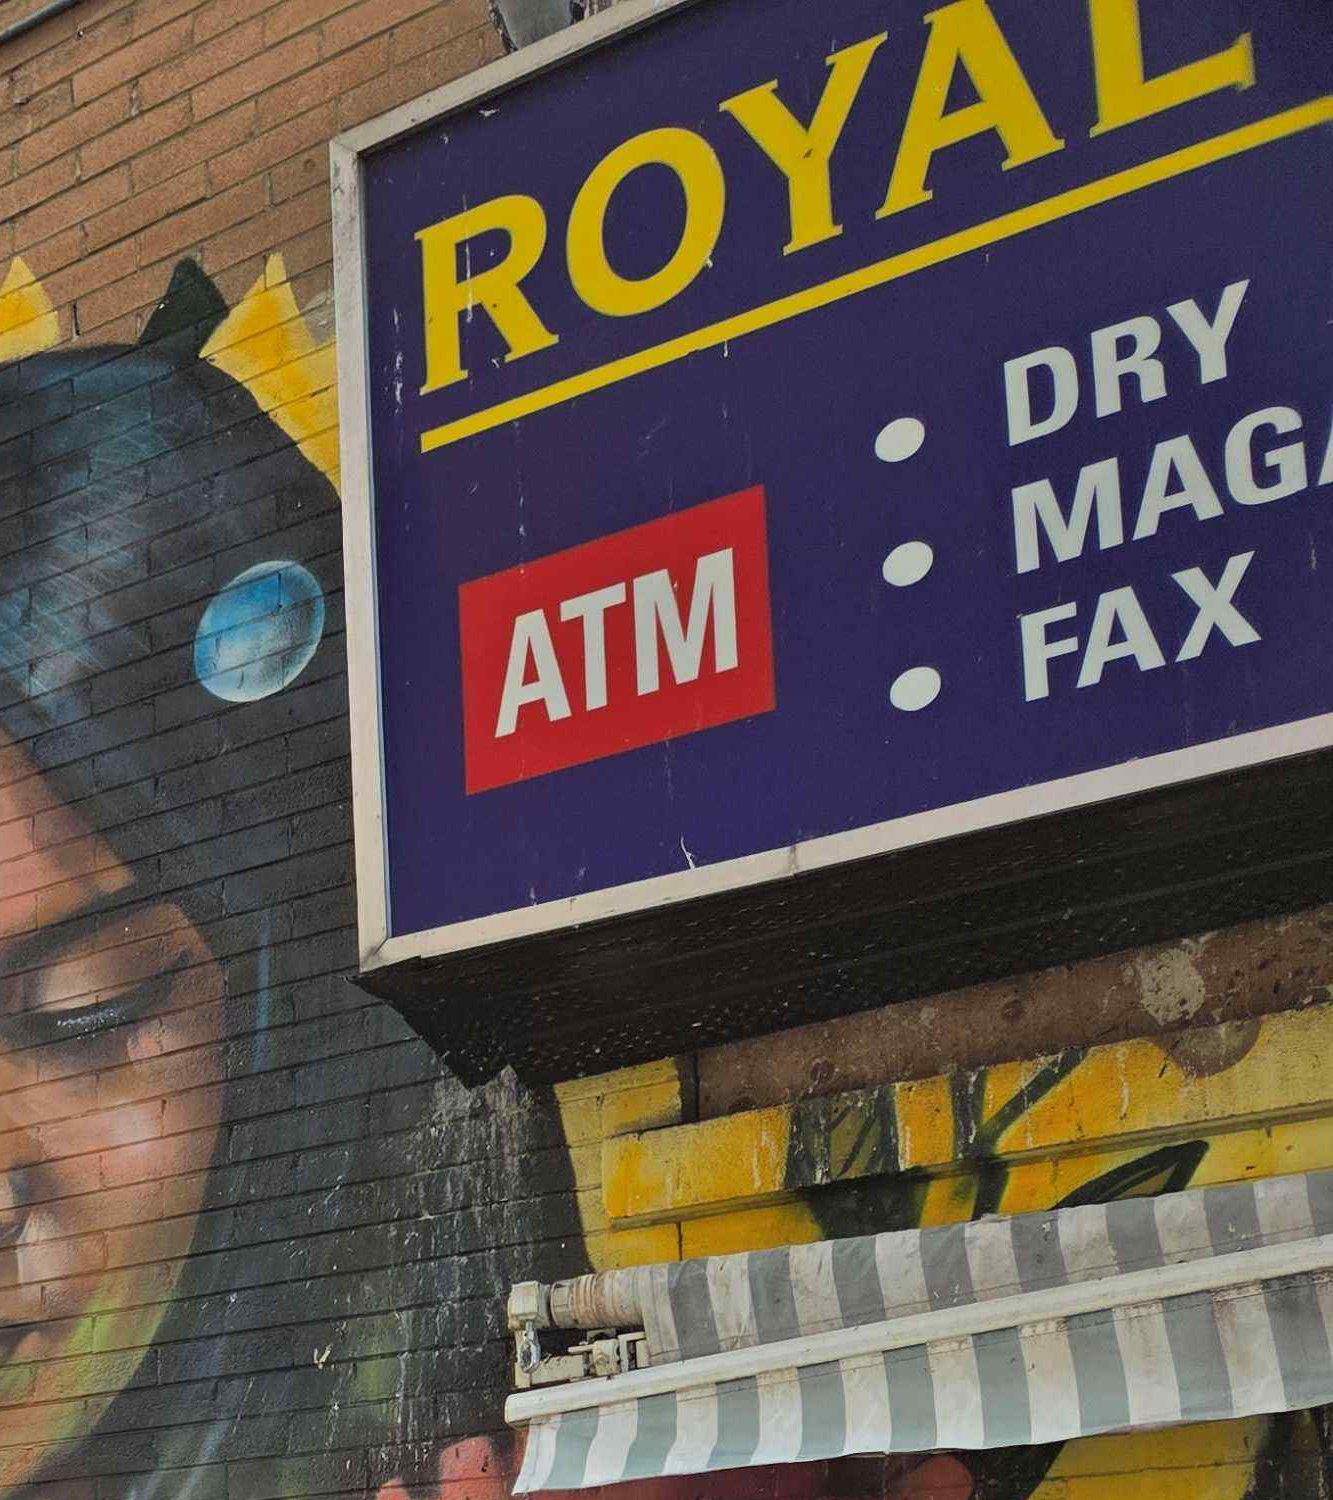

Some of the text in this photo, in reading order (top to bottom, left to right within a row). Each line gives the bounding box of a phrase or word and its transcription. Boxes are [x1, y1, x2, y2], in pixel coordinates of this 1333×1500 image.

[415, 0, 1255, 396] ROYAL
[1002, 279, 1250, 449] DRY
[1011, 405, 1333, 575] MAG
[494, 547, 740, 739] ATM
[1018, 551, 1262, 703] FAX
